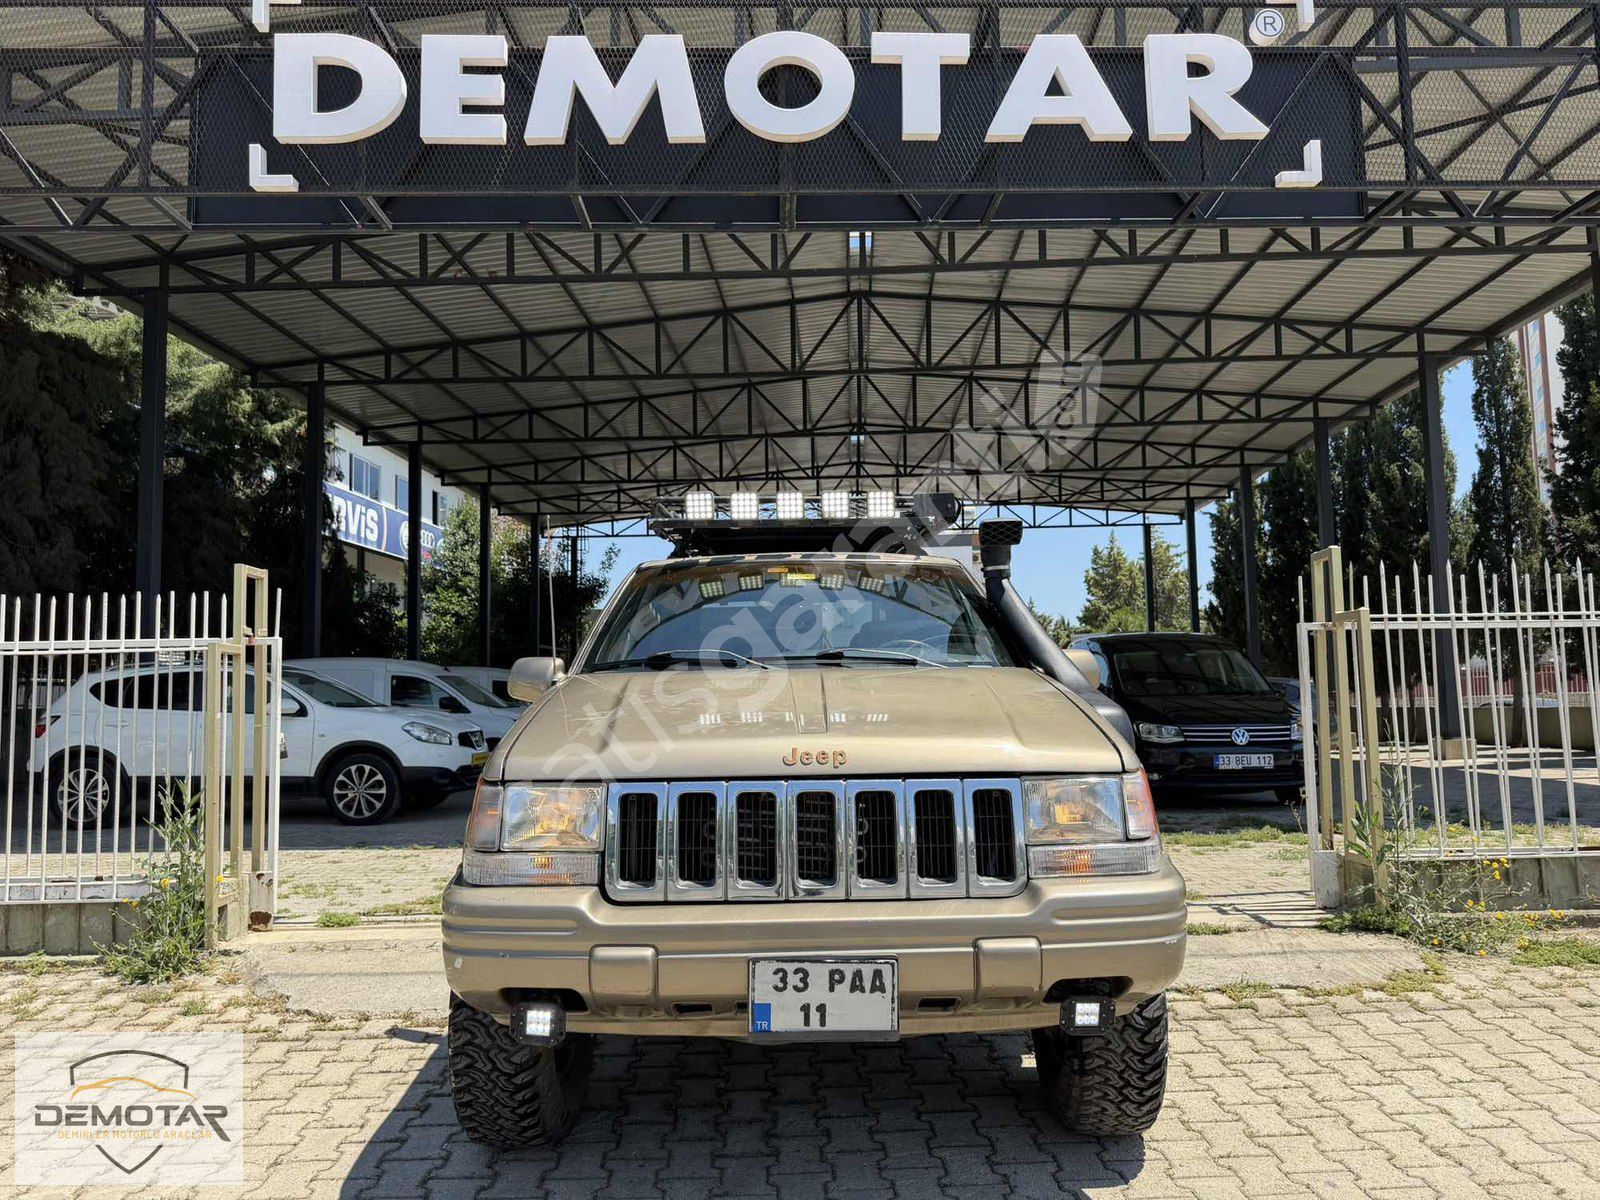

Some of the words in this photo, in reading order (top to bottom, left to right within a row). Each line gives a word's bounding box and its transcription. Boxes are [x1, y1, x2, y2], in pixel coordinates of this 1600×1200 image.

[272, 30, 1270, 146] DEMOTAR
[782, 746, 848, 769] Jeep
[1219, 755, 1231, 766] 33
[1257, 755, 1273, 766] 112
[771, 967, 810, 993] 33
[828, 968, 886, 994] PAA
[755, 1020, 769, 1030] TR
[799, 1002, 828, 1028] 11
